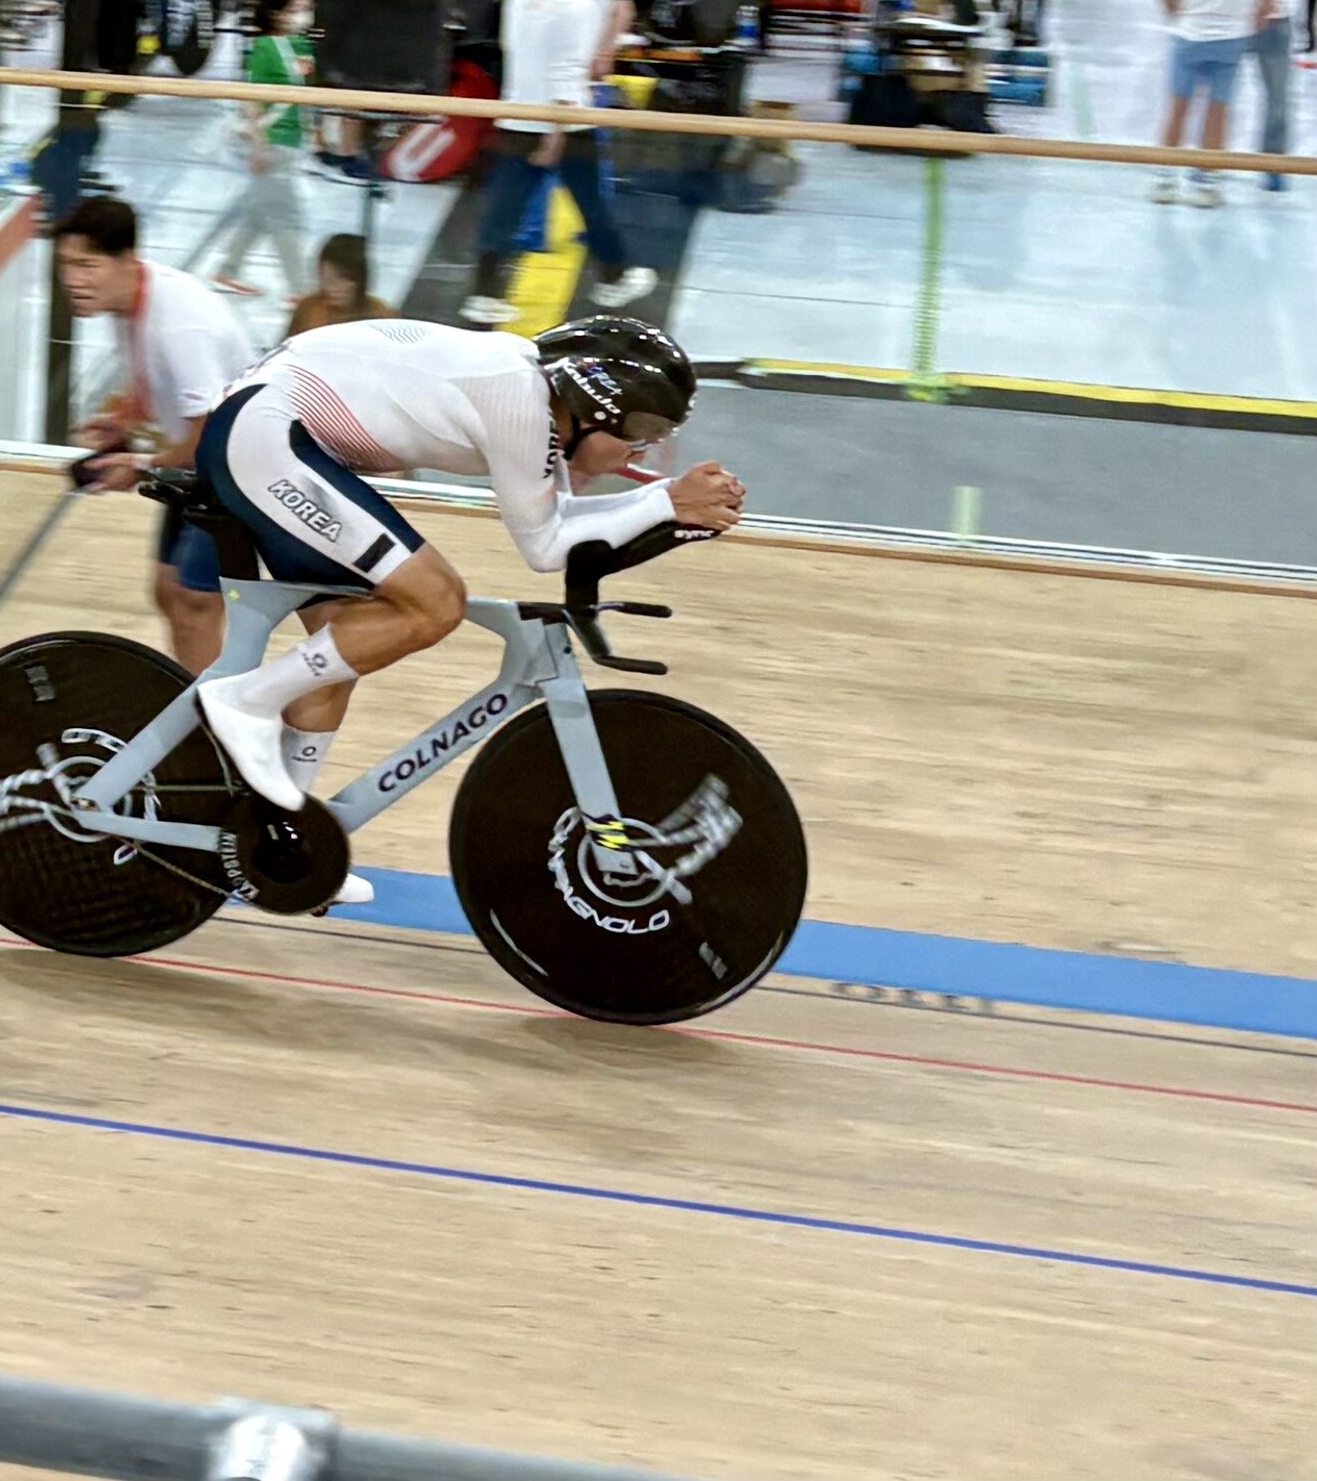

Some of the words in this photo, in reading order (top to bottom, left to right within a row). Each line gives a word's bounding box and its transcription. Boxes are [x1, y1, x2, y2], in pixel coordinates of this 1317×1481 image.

[267, 479, 342, 543] KOREA
[674, 529, 715, 539] sync
[378, 693, 508, 792] COLNAGO
